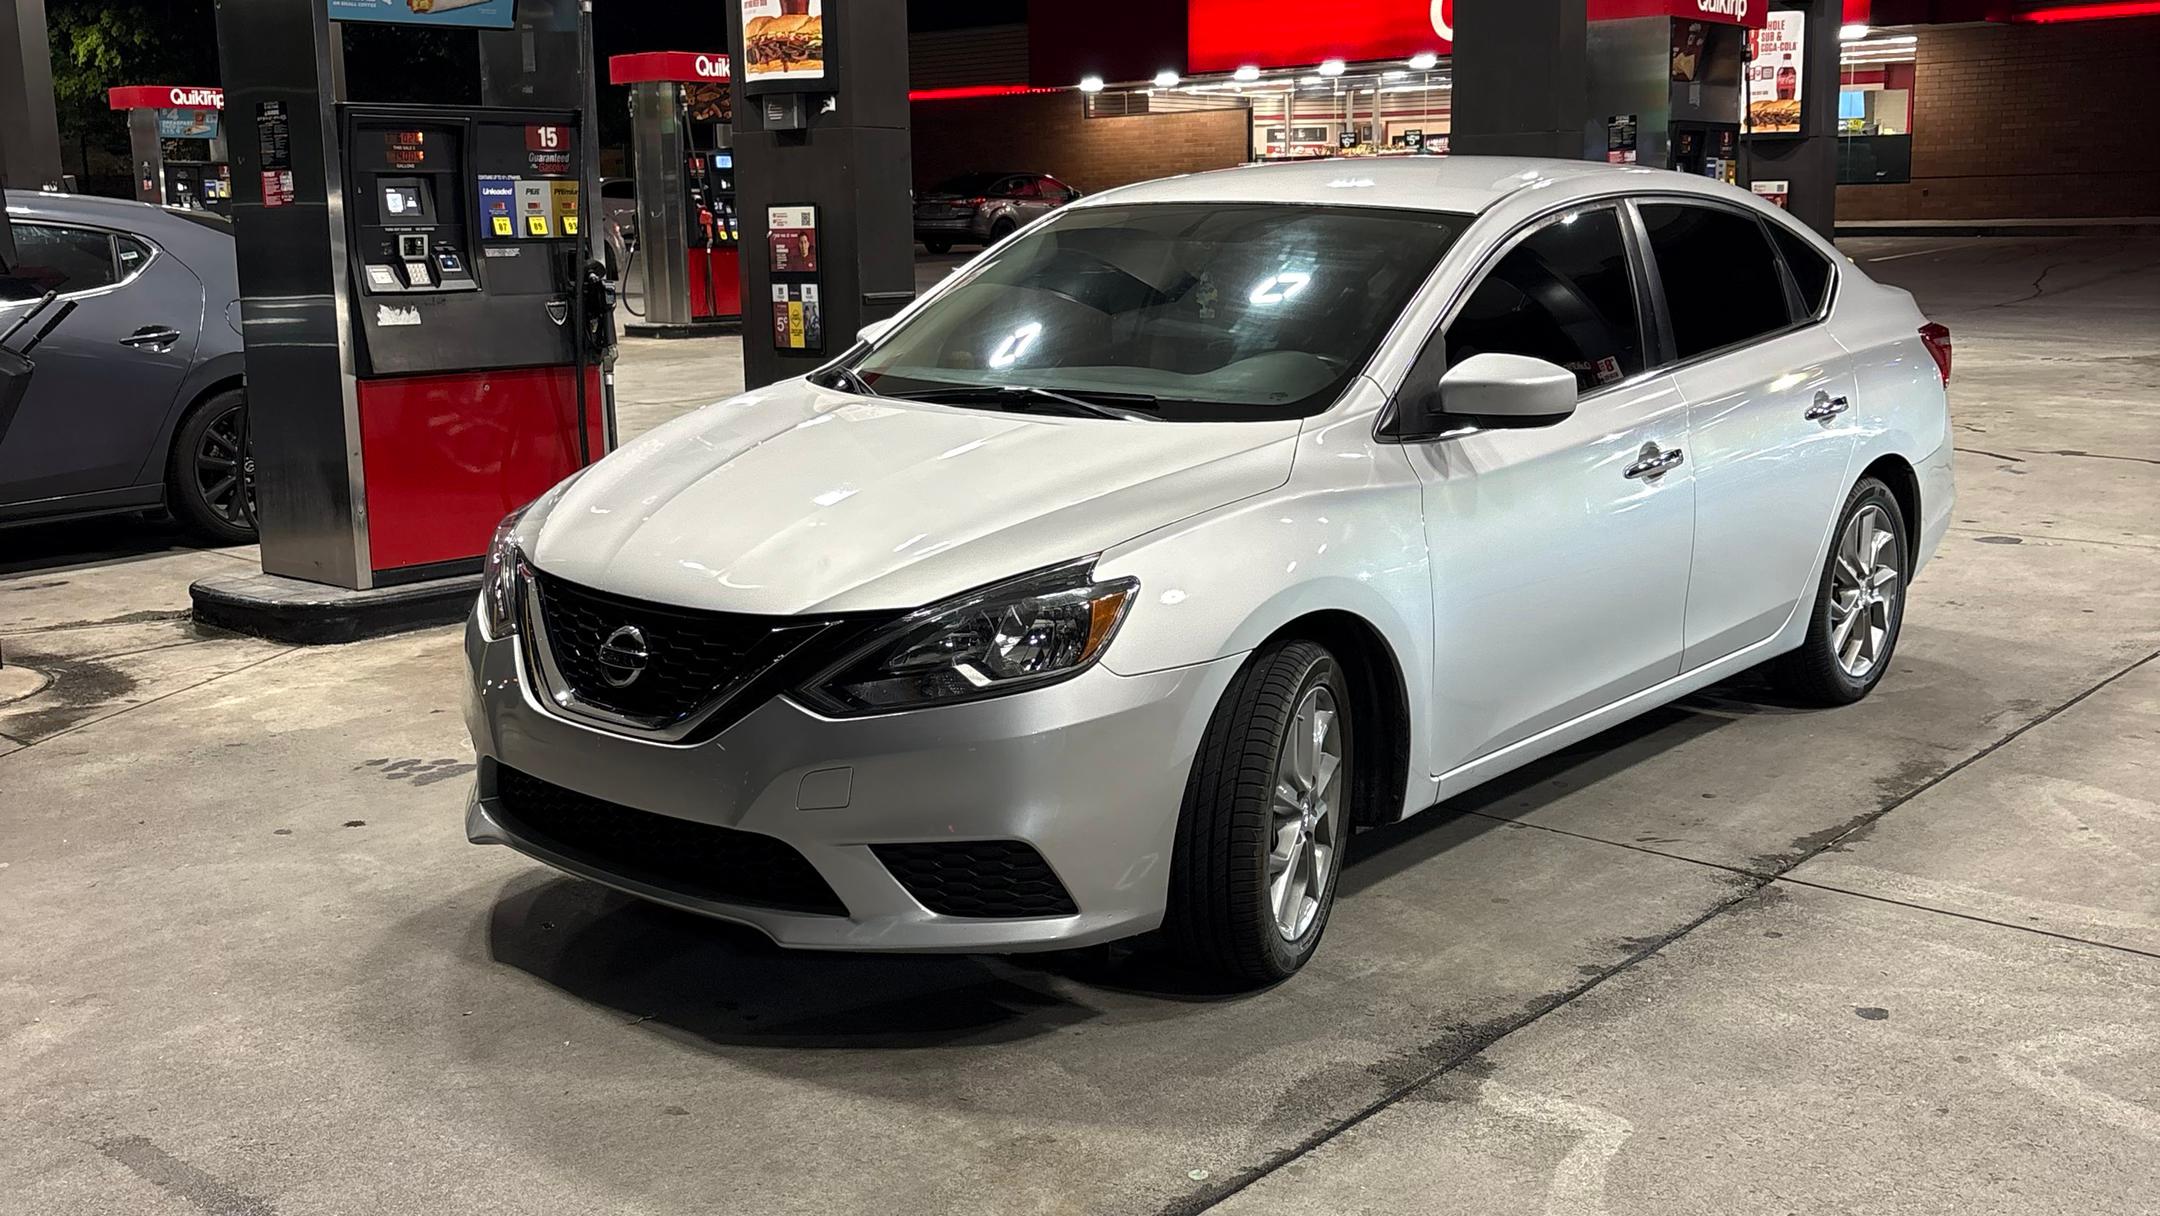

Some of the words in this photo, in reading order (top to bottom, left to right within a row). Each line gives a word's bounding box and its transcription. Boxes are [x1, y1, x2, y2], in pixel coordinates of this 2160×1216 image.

[1763, 20, 1785, 30] HOLE
[1761, 32, 1774, 42] SUB
[1776, 31, 1782, 41] &
[1761, 42, 1797, 52] COCA-COLA
[695, 55, 731, 78] Quik
[170, 88, 224, 110] QuikTrip
[537, 126, 558, 148] 15
[528, 152, 570, 163] Guaranteed
[482, 188, 513, 196] Unleaded
